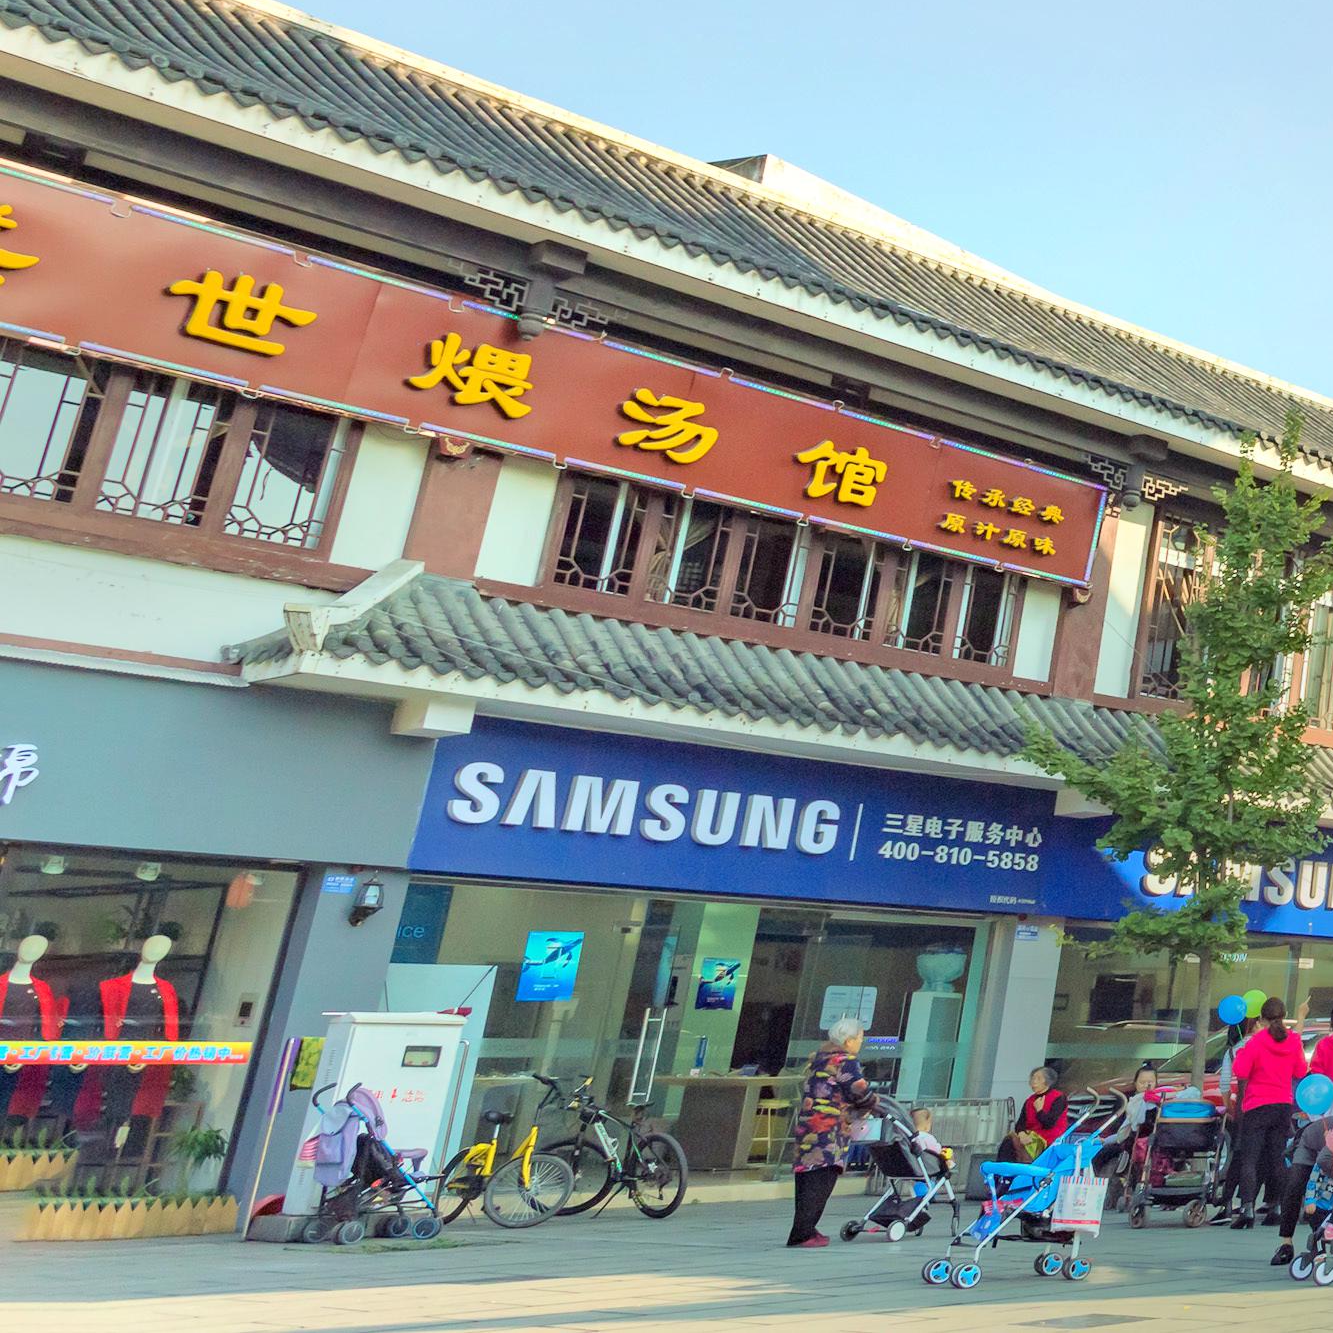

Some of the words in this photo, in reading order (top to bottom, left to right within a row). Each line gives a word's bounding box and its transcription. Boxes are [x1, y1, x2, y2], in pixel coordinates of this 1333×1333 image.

[951, 480, 1065, 525] 传承经典
[940, 512, 1057, 556] 原汁原味
[446, 761, 841, 856] SAMSUNG
[881, 813, 1043, 848] 三星电子服务中心
[878, 840, 1040, 872] 400-810-5858
